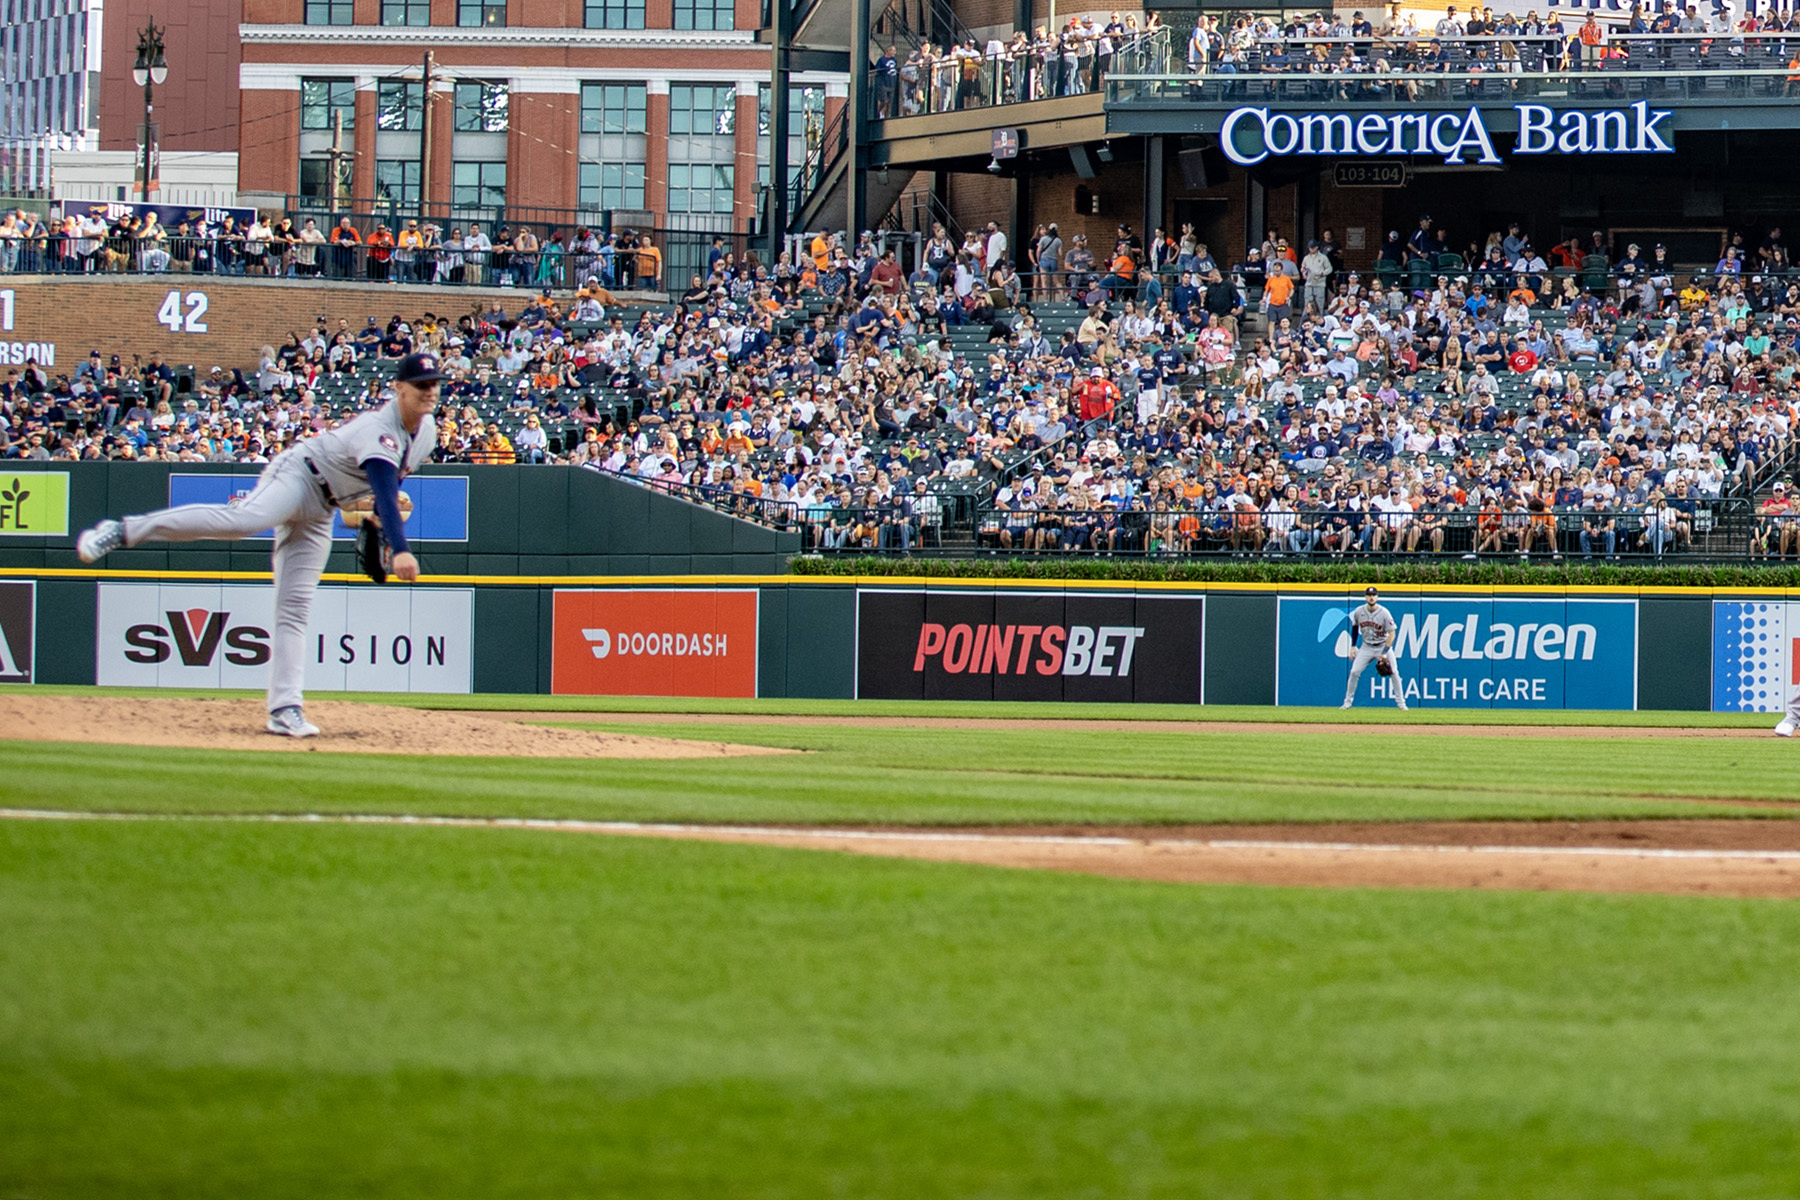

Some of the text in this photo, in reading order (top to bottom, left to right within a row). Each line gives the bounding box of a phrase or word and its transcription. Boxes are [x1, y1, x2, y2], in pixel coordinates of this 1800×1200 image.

[1512, 99, 1677, 155] Bank
[107, 203, 134, 221] Lite
[204, 207, 230, 225] Lite
[157, 290, 209, 333] 42
[316, 633, 446, 667] ISION
[618, 632, 728, 657] DOORDASH
[913, 622, 1145, 677] POINTSBET
[1393, 613, 1597, 661] McLaren
[1478, 678, 1547, 701] CARE
